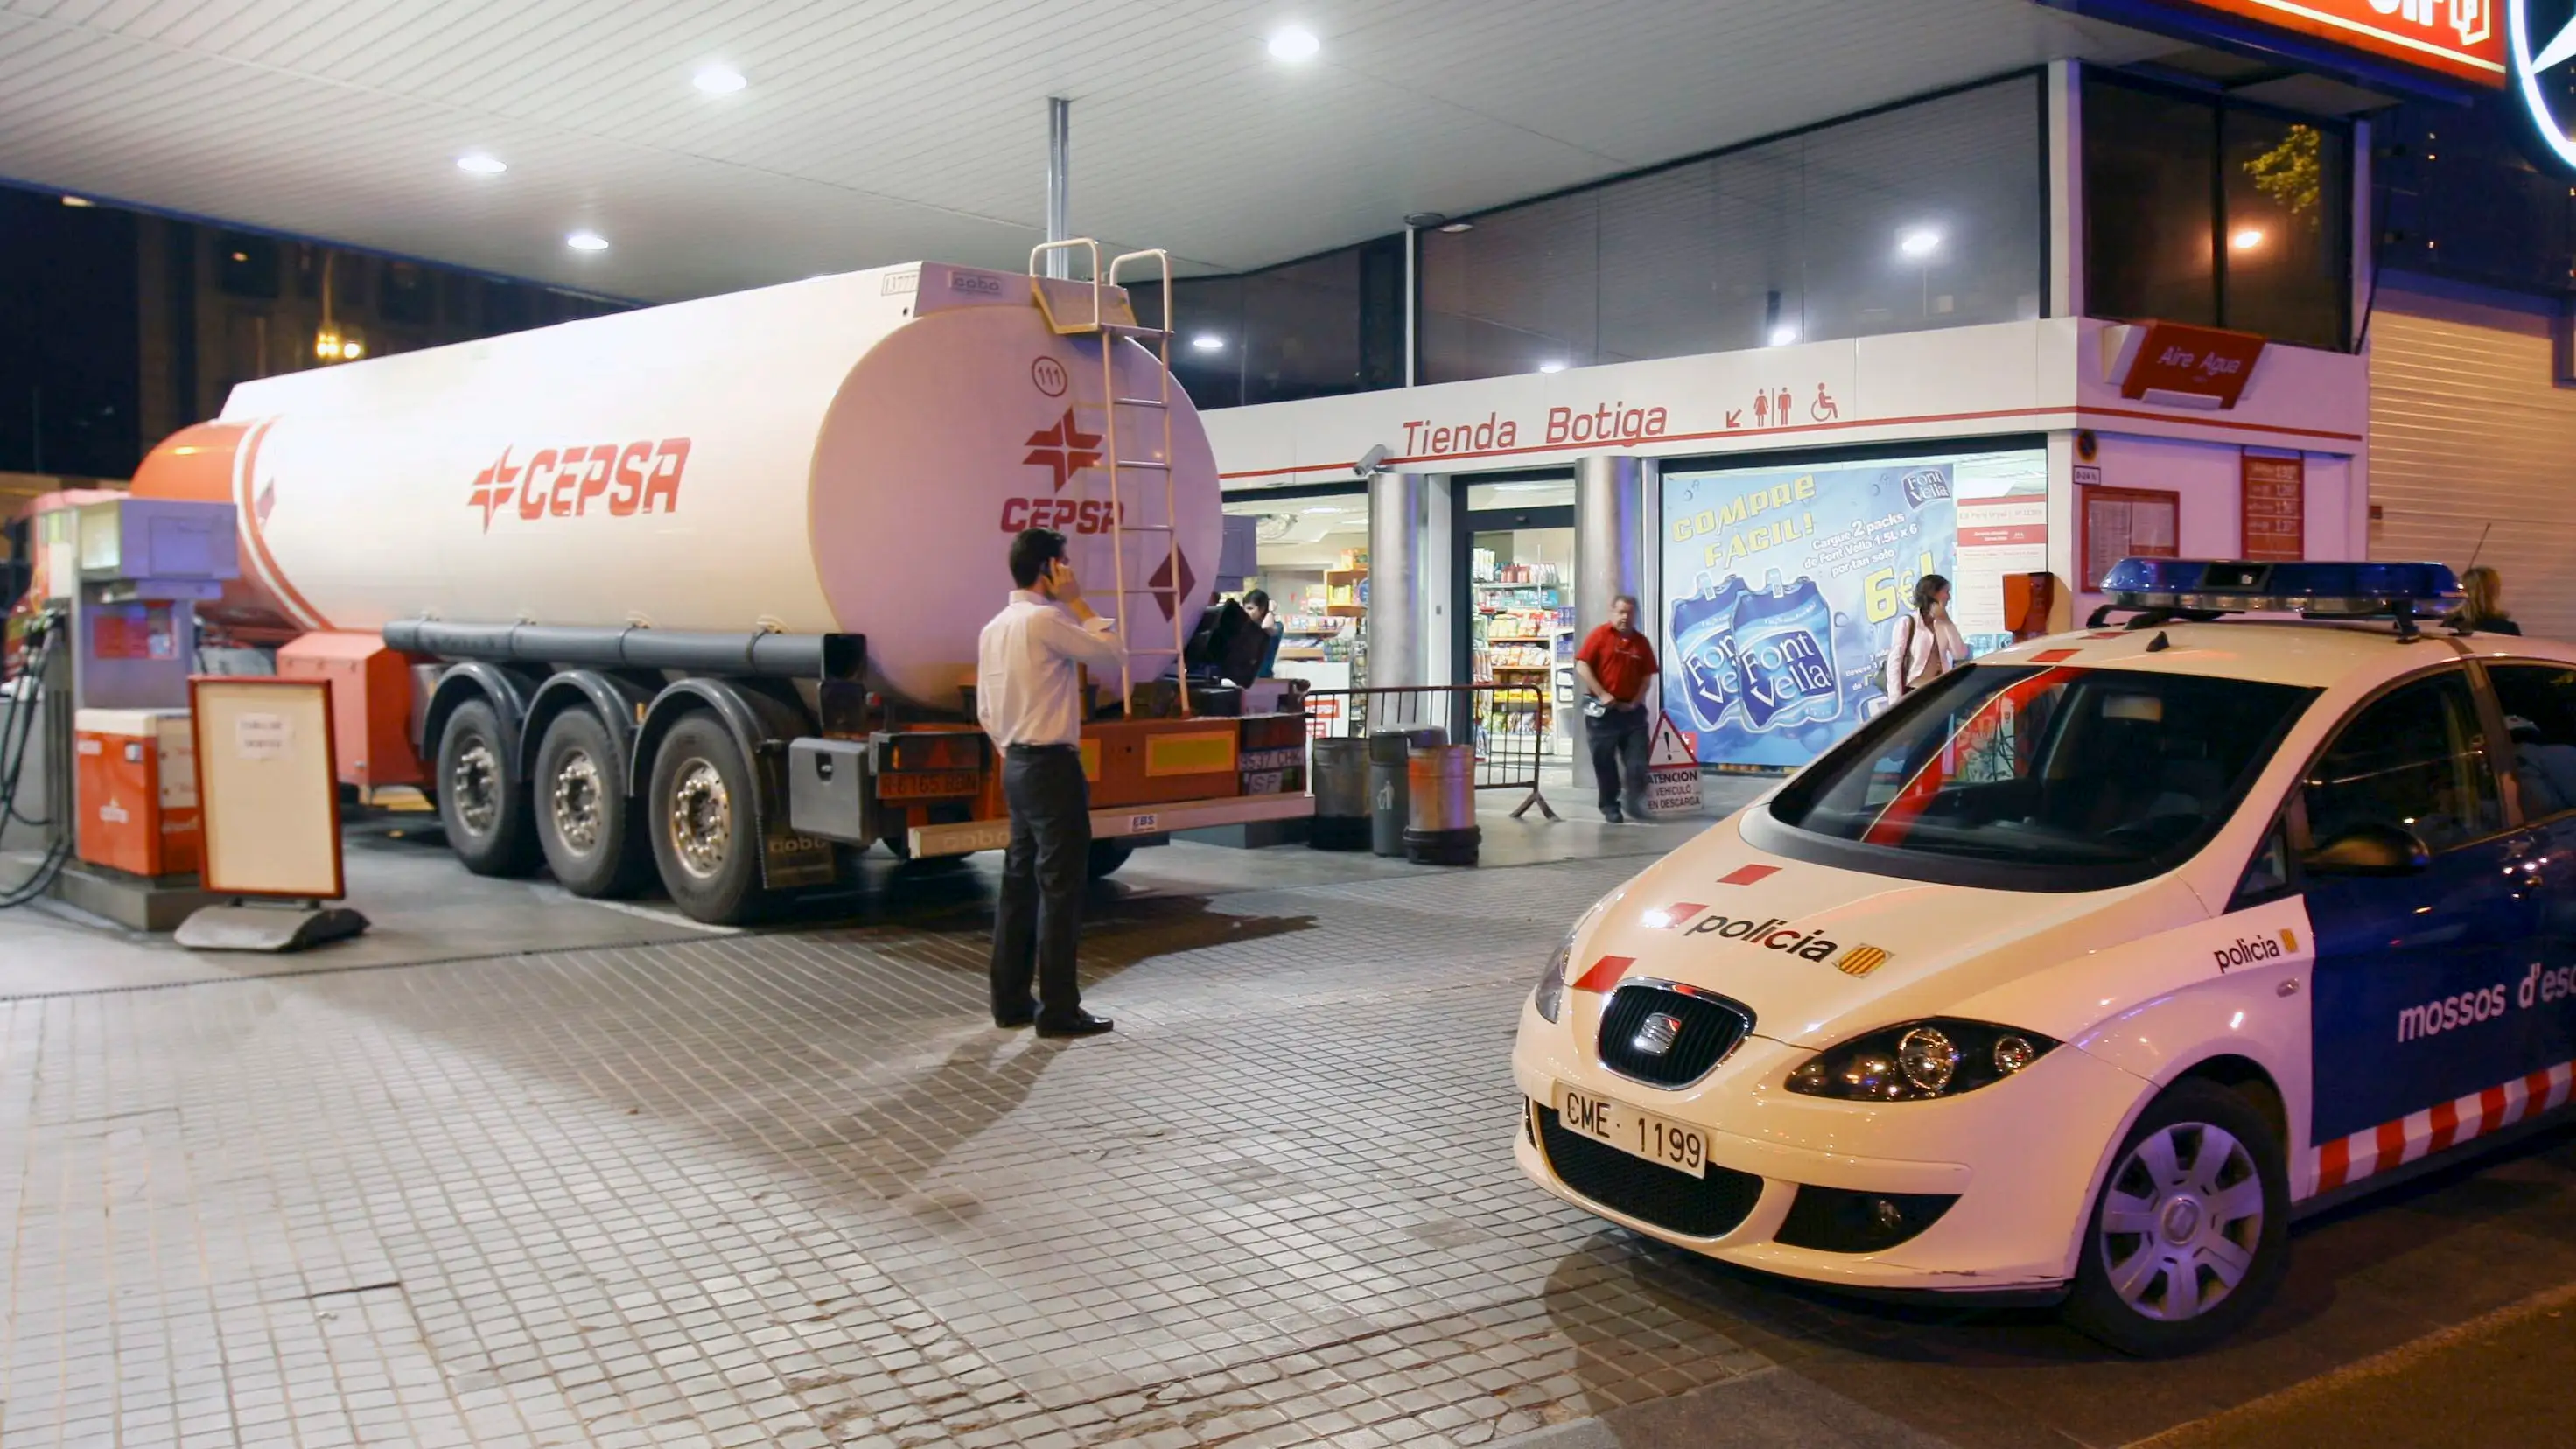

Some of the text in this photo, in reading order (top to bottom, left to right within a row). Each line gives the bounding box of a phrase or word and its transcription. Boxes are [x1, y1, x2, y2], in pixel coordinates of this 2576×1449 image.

[2156, 346, 2241, 376] Aire Agua
[1403, 400, 1668, 456] Tienda Botiga
[518, 438, 691, 520] CEPSA
[1907, 471, 1942, 491] Font
[1909, 482, 1950, 502] Vella
[1000, 497, 1124, 535] CEPSA
[1672, 472, 1816, 543] COMPRE
[1803, 523, 1918, 570] de Font Vella 1.5L x 6
[1811, 512, 1906, 550] Cargue 2 packs
[1830, 562, 1852, 578] por
[1851, 556, 1871, 570] tan
[1686, 634, 1739, 687] Fon
[1741, 632, 1816, 685] Font
[1750, 661, 1832, 708] Vella
[1253, 773, 1278, 793] SP
[1660, 796, 1700, 808] DESCARGA
[1133, 816, 1155, 826] EBS
[2214, 934, 2280, 974] policia
[2398, 983, 2507, 1043] mossos
[1638, 1117, 1702, 1169] 1199
